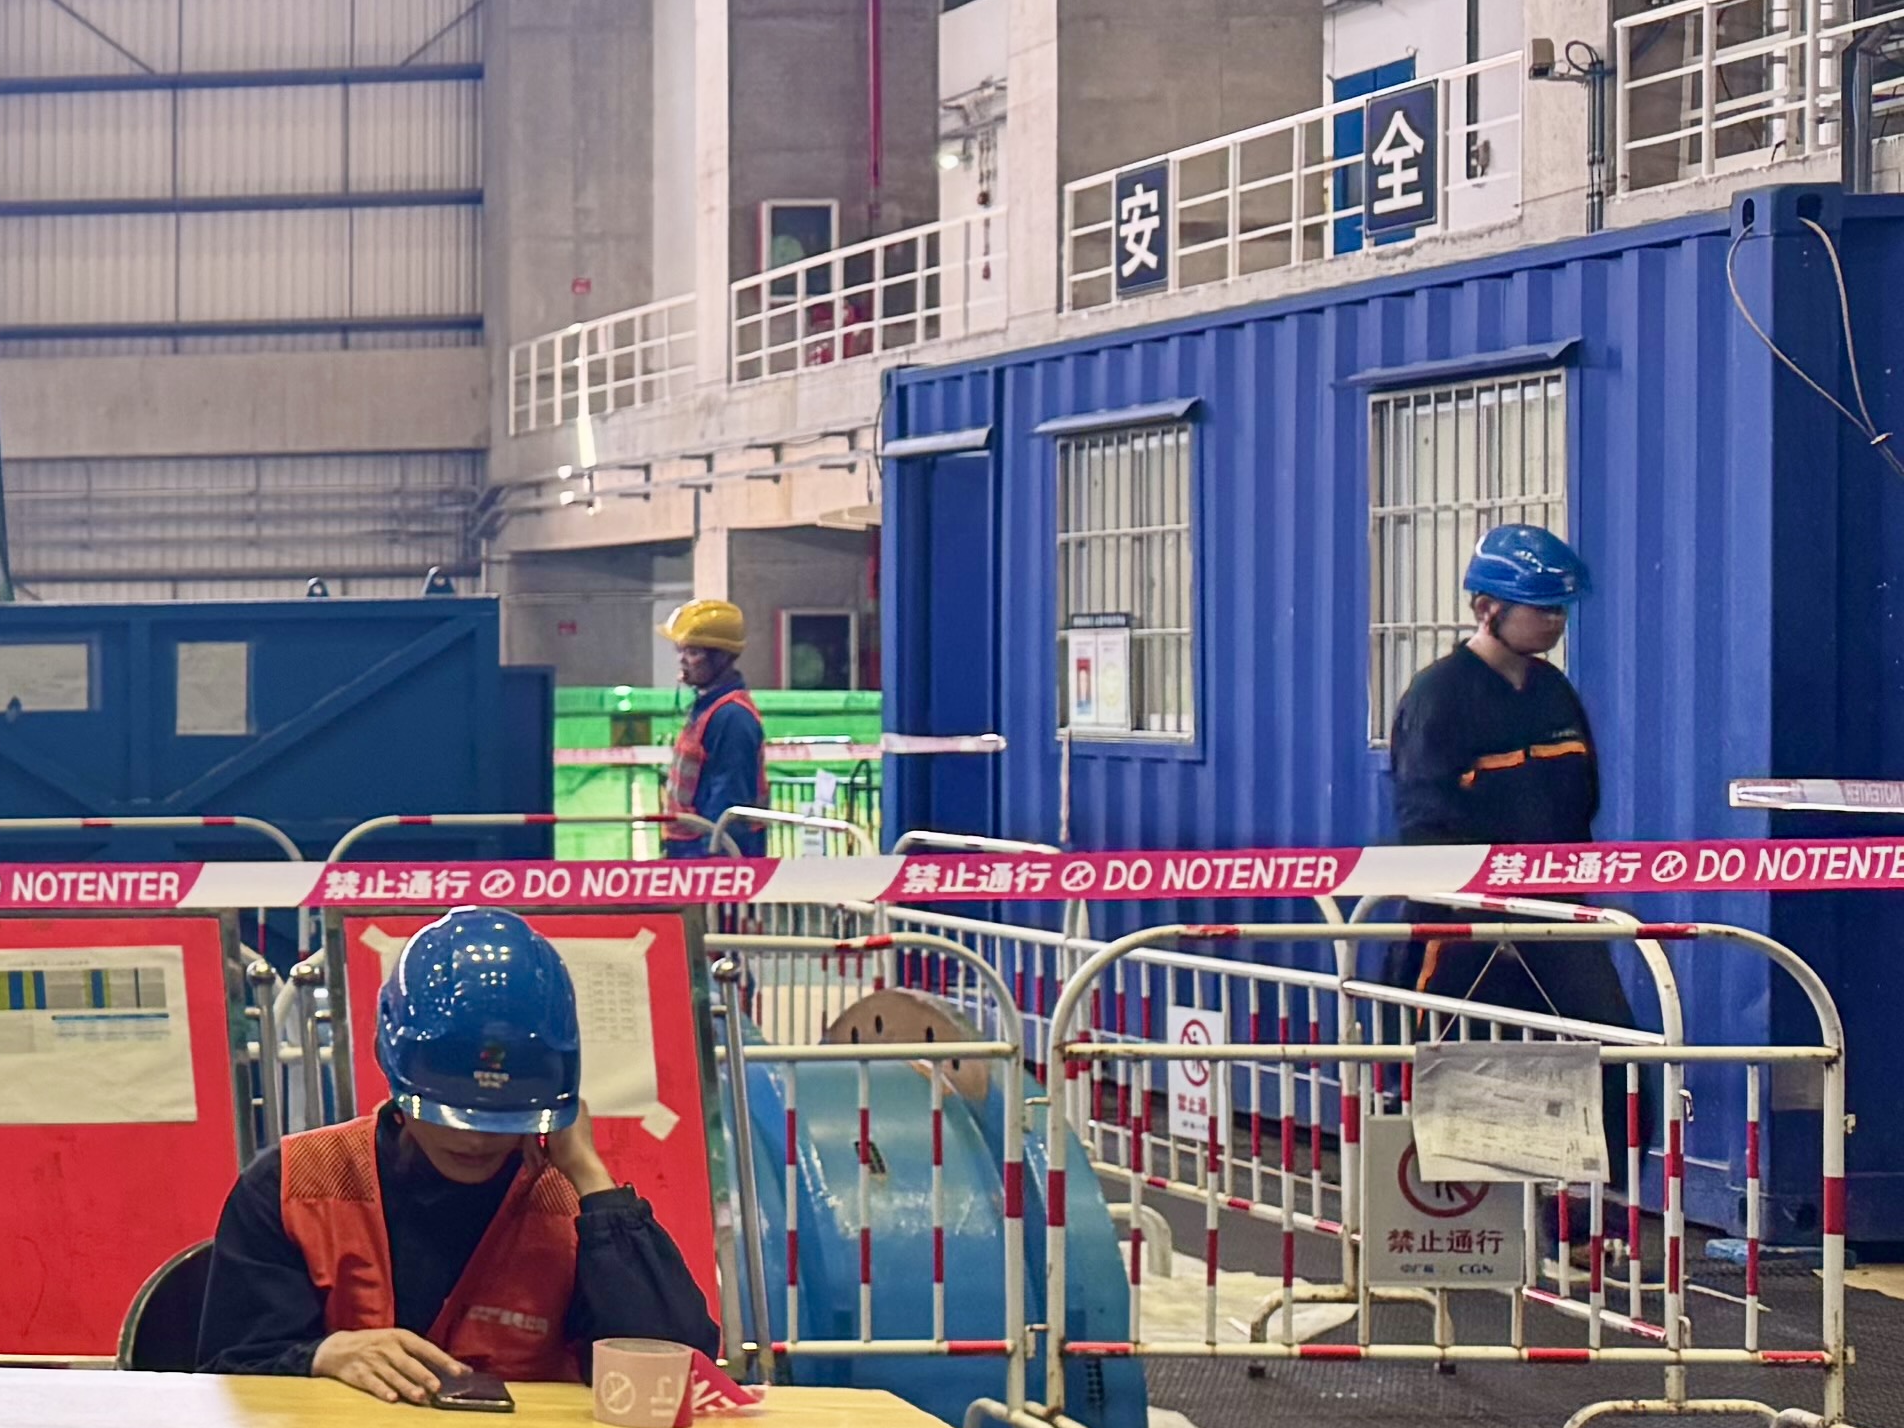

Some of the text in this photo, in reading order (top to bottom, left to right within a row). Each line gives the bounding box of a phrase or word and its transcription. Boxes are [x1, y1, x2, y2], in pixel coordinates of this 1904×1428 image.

[1370, 109, 1425, 214] 全
[1119, 183, 1159, 278] 安
[522, 866, 754, 899] DO NOTENTER
[901, 861, 1052, 894] 禁止通行
[1102, 855, 1338, 892] DO NOTENTER
[1486, 851, 1642, 886] 禁止通行
[1693, 848, 1746, 883] DO
[11, 871, 180, 902] NOTENTER
[323, 869, 471, 900] 禁止通行
[1387, 1228, 1504, 1255] 禁止通行
